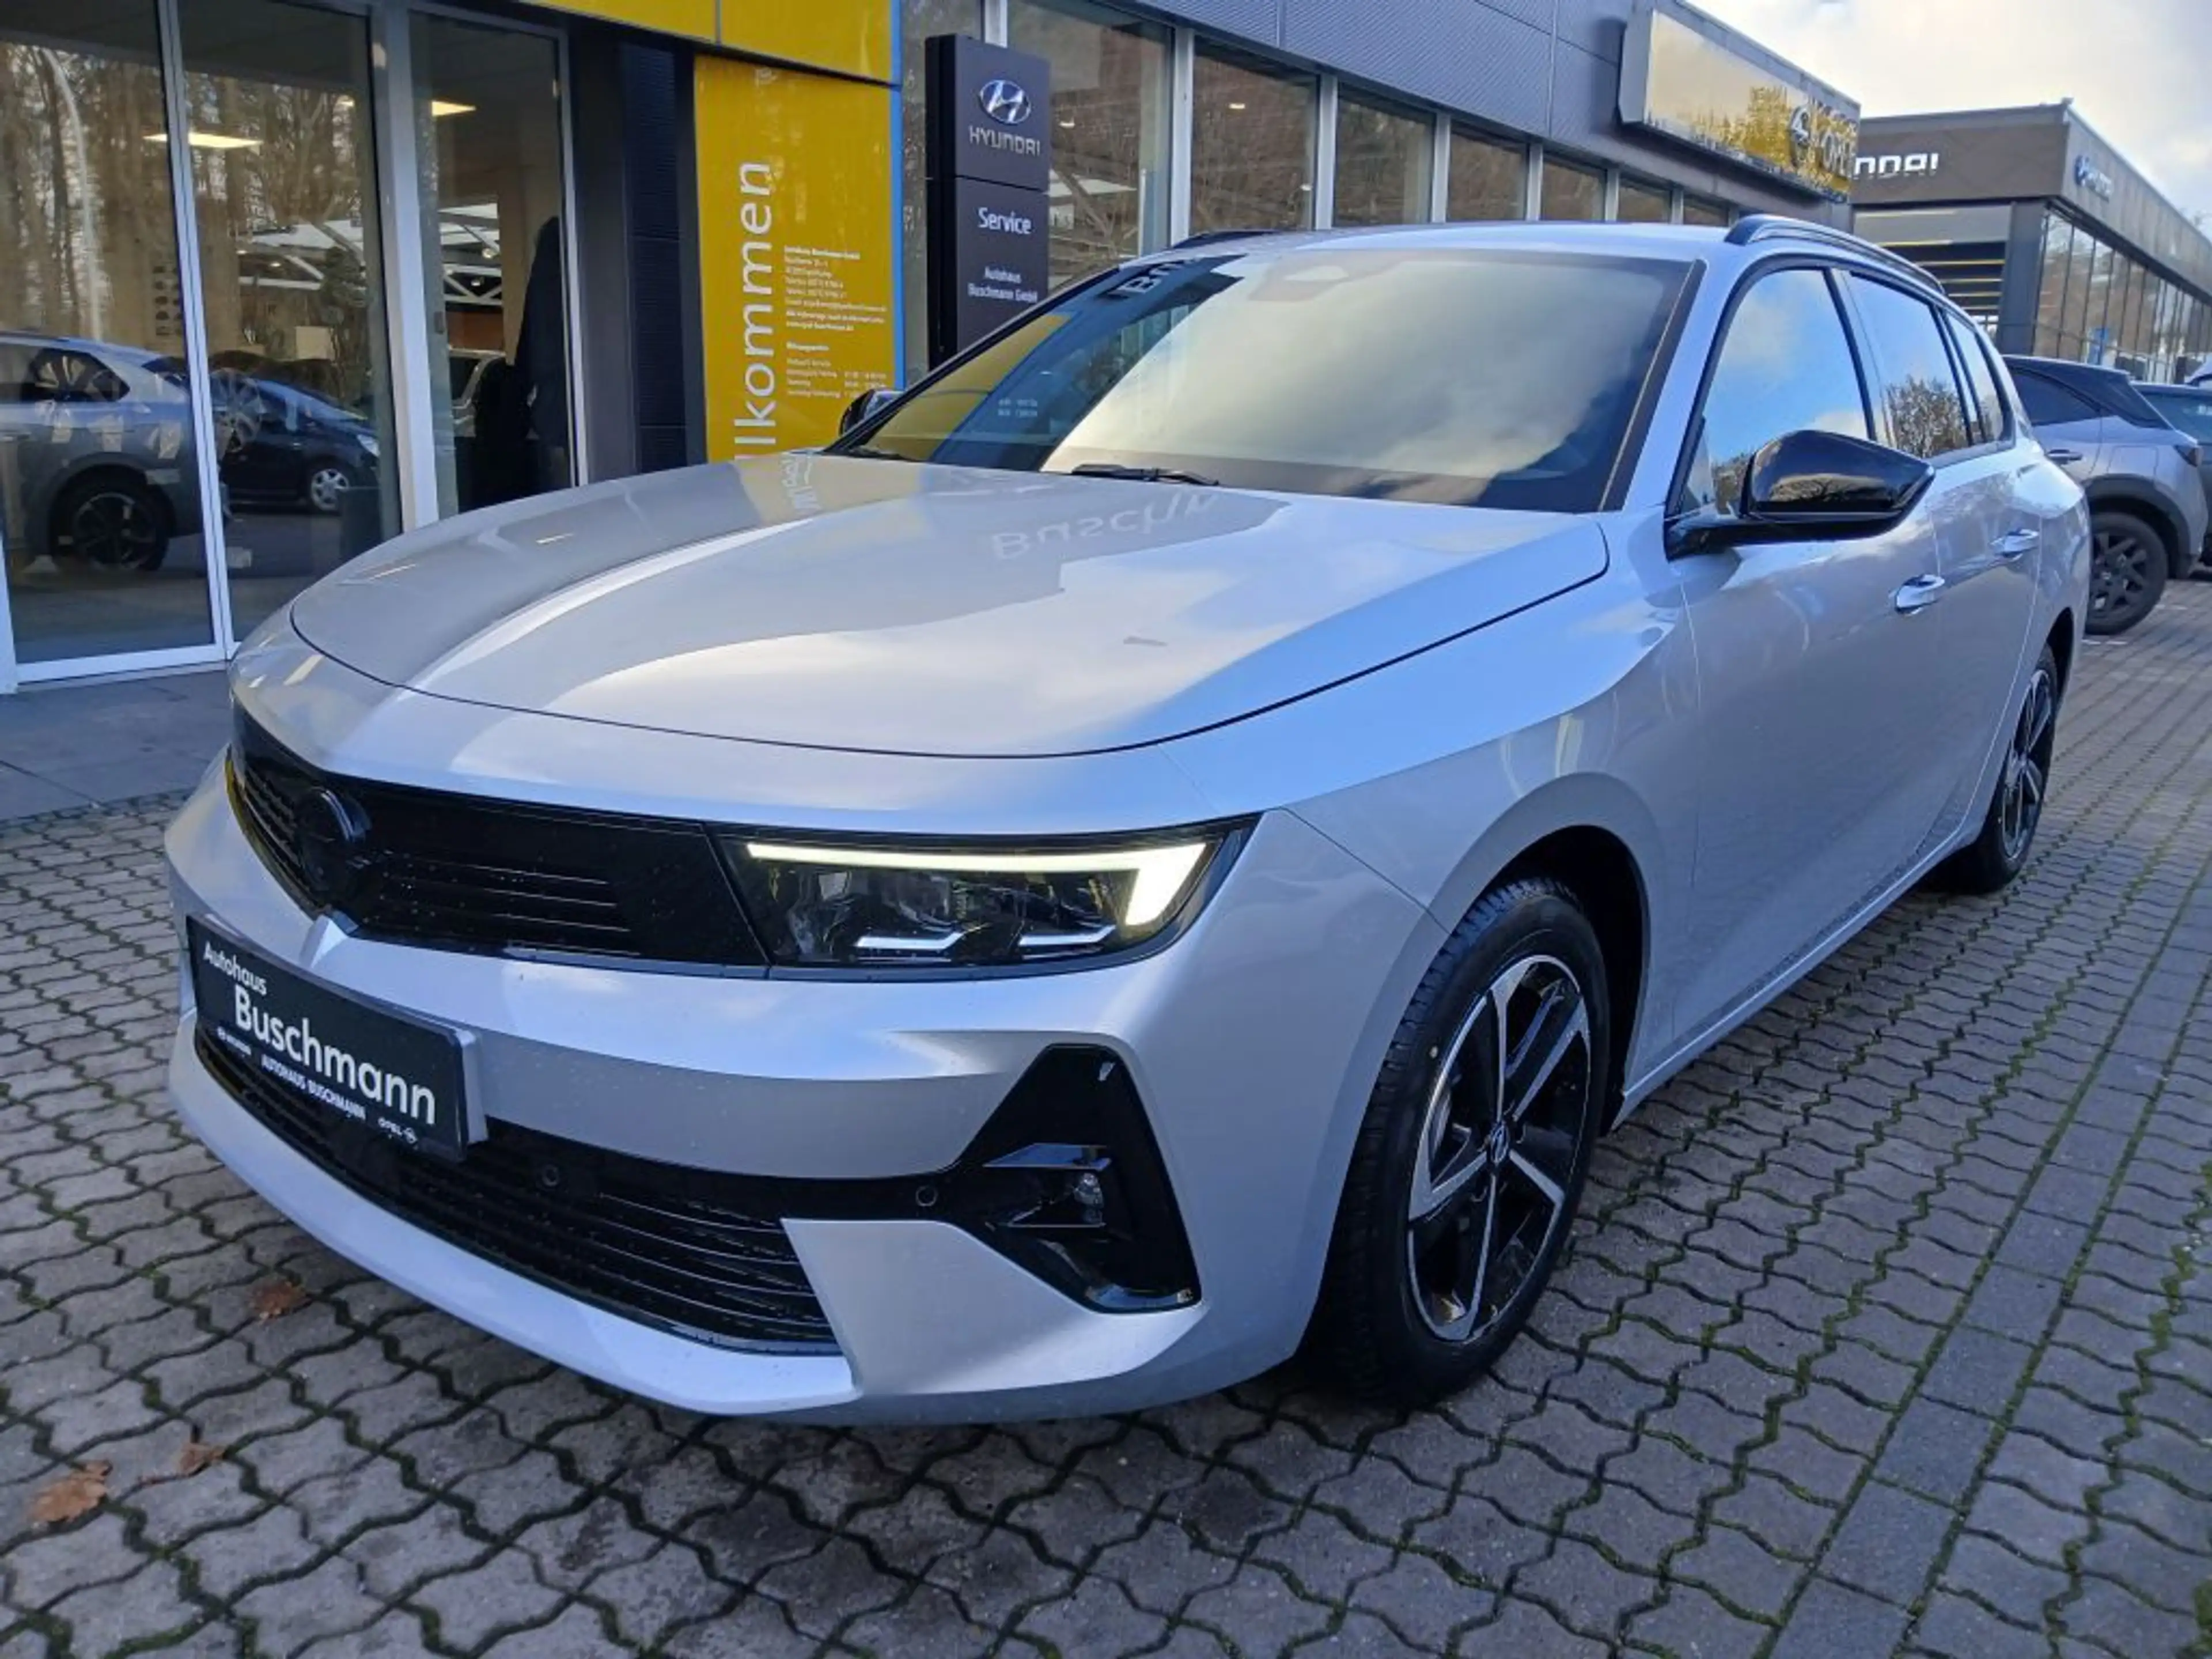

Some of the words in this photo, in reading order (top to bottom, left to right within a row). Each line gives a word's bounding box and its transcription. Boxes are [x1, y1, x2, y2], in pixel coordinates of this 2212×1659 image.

[968, 125, 1040, 157] HYUNDAI
[978, 207, 1032, 234] Service
[984, 266, 1021, 284] Autohaus
[968, 282, 1014, 300] Buschmann
[203, 941, 267, 996] Autohaus
[234, 985, 435, 1124] Buschmann
